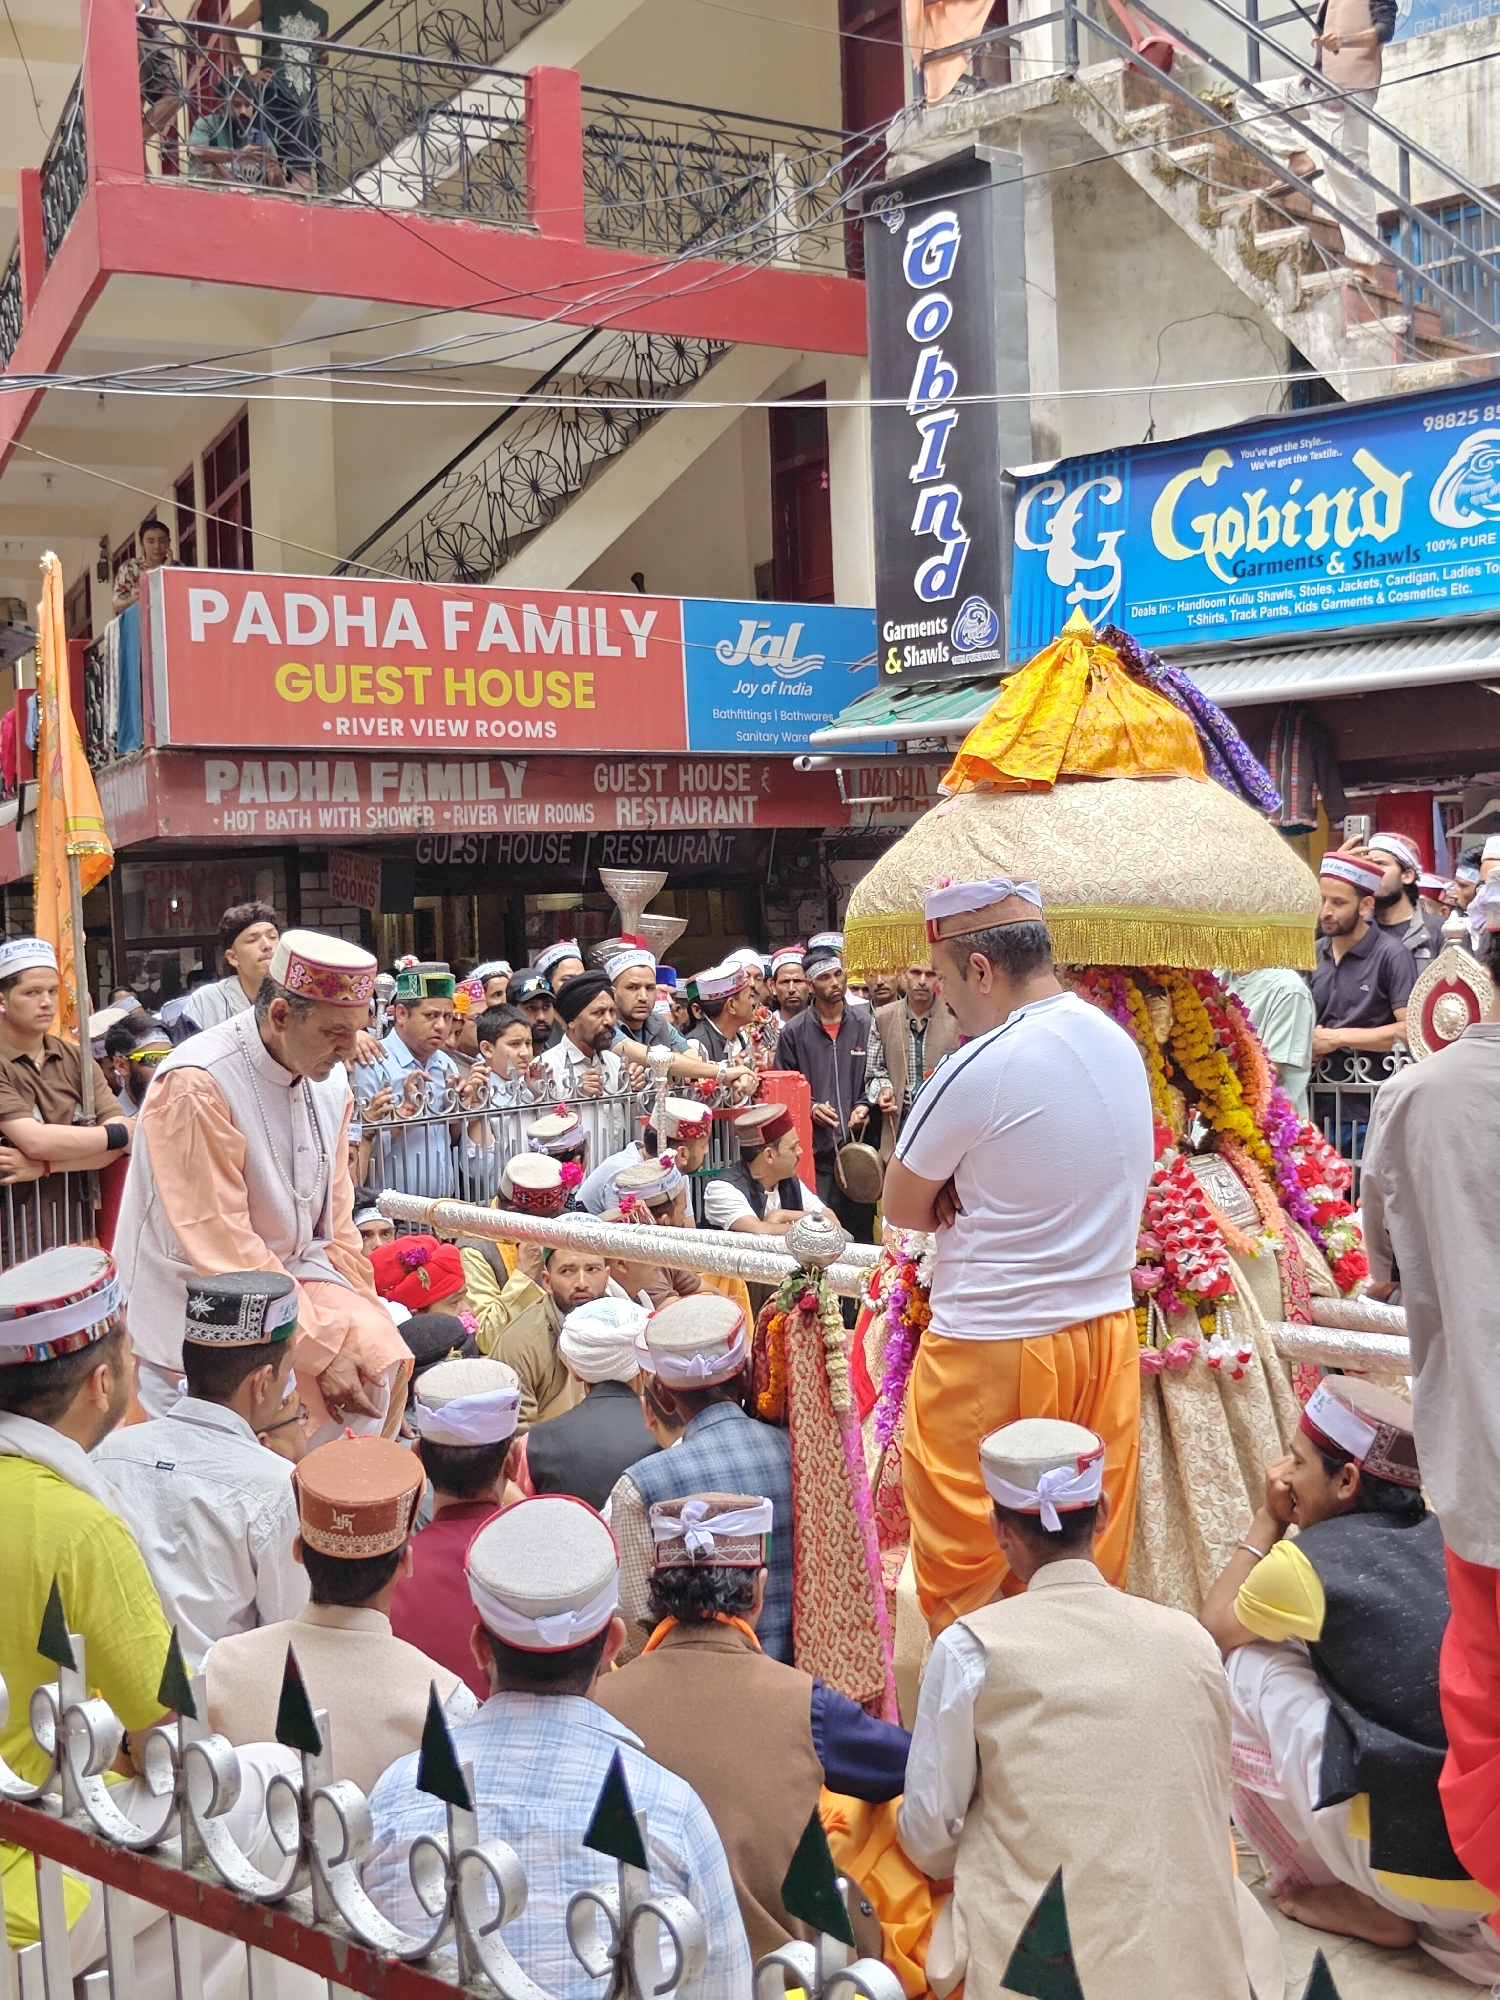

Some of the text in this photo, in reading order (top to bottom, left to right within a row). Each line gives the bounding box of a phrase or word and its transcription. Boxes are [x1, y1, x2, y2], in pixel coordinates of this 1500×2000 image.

[1423, 409, 1479, 433] 98825
[1240, 447, 1268, 459] You've
[1268, 444, 1283, 457] got
[1284, 441, 1299, 452] the
[1250, 459, 1277, 472] We've
[1277, 456, 1292, 469] got
[1293, 453, 1308, 463] the
[1151, 448, 1413, 585] Gobind
[1425, 531, 1497, 553] 100% PURE
[1232, 544, 1421, 579] Garments & Shawls
[1131, 605, 1157, 618] Deals
[1176, 598, 1226, 613] Handloom
[1228, 593, 1254, 606] Kullu
[1256, 588, 1297, 604] Shawls,
[1299, 584, 1335, 598] Stoles,
[1338, 577, 1383, 593] Jackets,
[1386, 570, 1440, 588] Cardigan,
[1443, 564, 1481, 580] Ladies
[1484, 560, 1500, 575] To
[1187, 582, 1473, 627] T-Shirts, Track Pants, Kids Garments & Cosmetics Etc.
[188, 588, 659, 659] PADHA FAMILY
[882, 617, 948, 643] Garments
[884, 641, 950, 675] & Shawls
[275, 662, 596, 709] GUEST HOUSE
[732, 680, 813, 699] Joy of India
[336, 717, 557, 739] RIVER VIEW ROOMS
[712, 708, 772, 724] Bathfittings
[780, 710, 834, 722] Bathwares
[736, 730, 779, 745] Sanitary
[205, 760, 528, 804] PADHA FAMILY
[594, 763, 668, 793] GUEST
[678, 763, 751, 792] HOUSE
[223, 803, 595, 831] HOT BATH WITH SHOWER RIVER VIEW ROOMS
[616, 795, 758, 826] RESTAURANT
[416, 834, 572, 864] GUEST HOUSE
[602, 834, 736, 864] RESTAURANT
[332, 874, 376, 908] ROOMS
